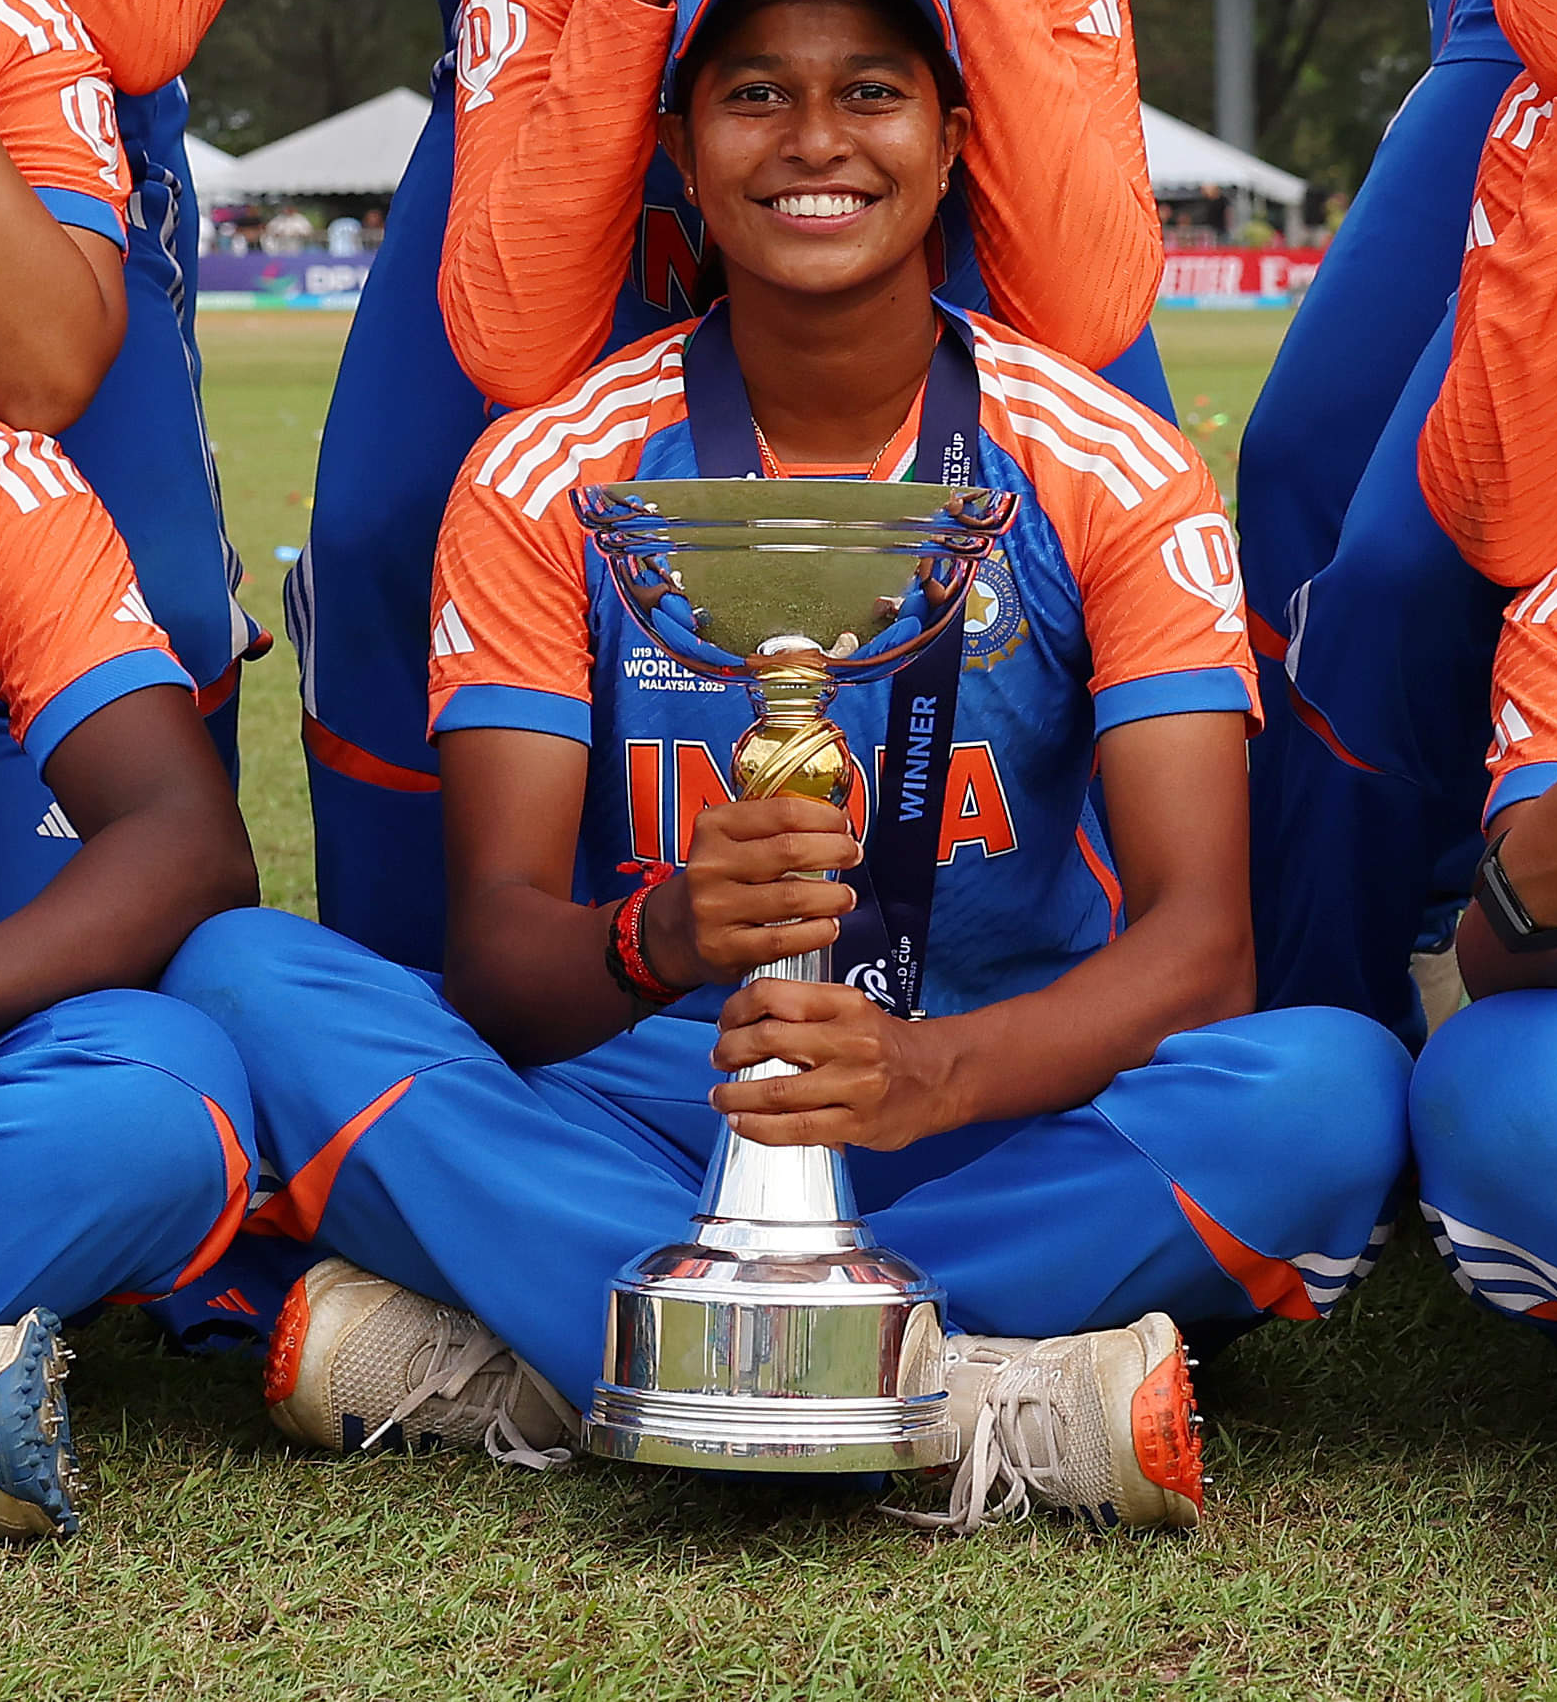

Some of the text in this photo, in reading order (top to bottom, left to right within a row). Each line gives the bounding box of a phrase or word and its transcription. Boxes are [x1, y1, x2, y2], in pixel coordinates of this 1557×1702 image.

[952, 432, 965, 461] CUP
[632, 647, 652, 658] U19
[639, 678, 726, 692] MALAYSIA 2025
[898, 695, 937, 822] WINNER
[898, 935, 912, 964] CUP
